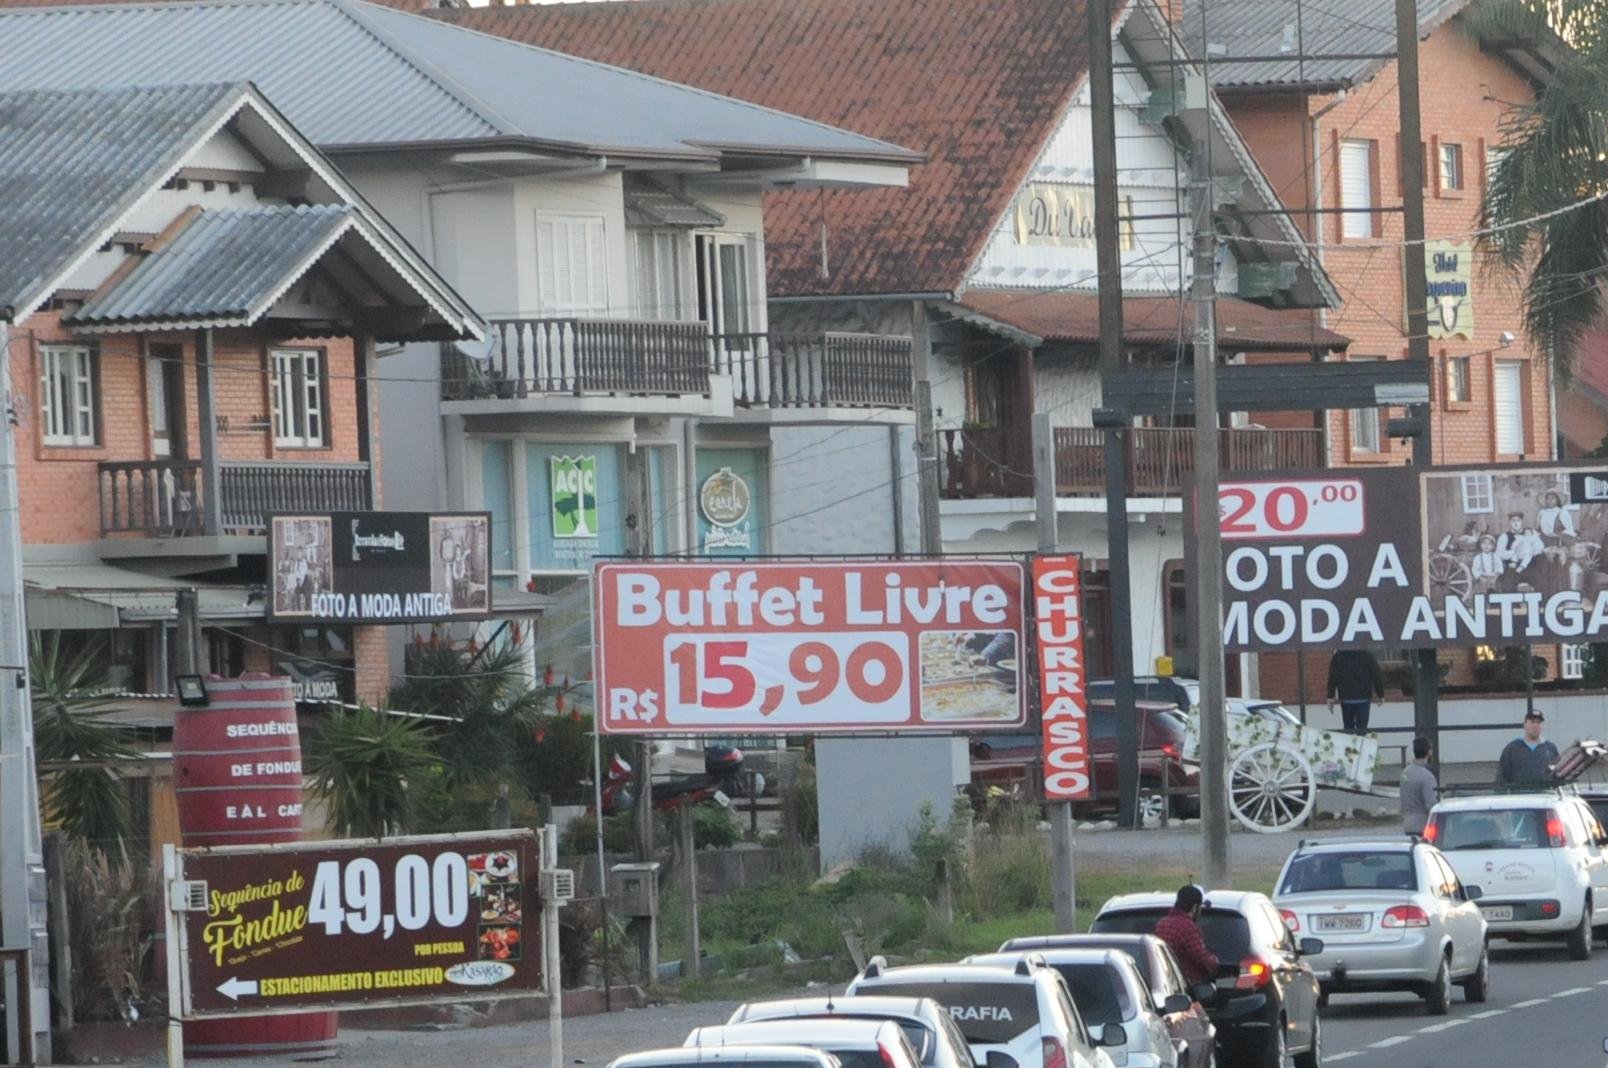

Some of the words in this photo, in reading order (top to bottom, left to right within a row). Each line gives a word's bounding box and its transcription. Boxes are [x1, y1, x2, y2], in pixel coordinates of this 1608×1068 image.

[1225, 543, 1349, 592] OTO
[1367, 543, 1409, 588] A
[311, 594, 345, 618] FOTO
[348, 594, 359, 618] A
[361, 594, 402, 618] MODA
[404, 592, 453, 616] ANTIGA
[616, 570, 825, 627] Buffet
[845, 572, 1008, 625] Livre
[305, 684, 312, 697] A
[313, 682, 338, 698] MODA
[610, 687, 659, 723] R$
[670, 640, 904, 716] 15,90
[1037, 570, 1090, 795] CHURRASCO
[231, 764, 253, 777] DE
[226, 806, 237, 818] E
[207, 878, 283, 917] Sequência
[285, 870, 305, 893] de
[308, 851, 469, 940] 49,00
[203, 900, 308, 967] Fondue
[414, 944, 432, 956] POR
[433, 942, 465, 955] PESSOA
[260, 971, 372, 996] ESTACIONAMENTO
[375, 967, 443, 988] EXCLUSIVO
[949, 1006, 1013, 1021] RAFIA
